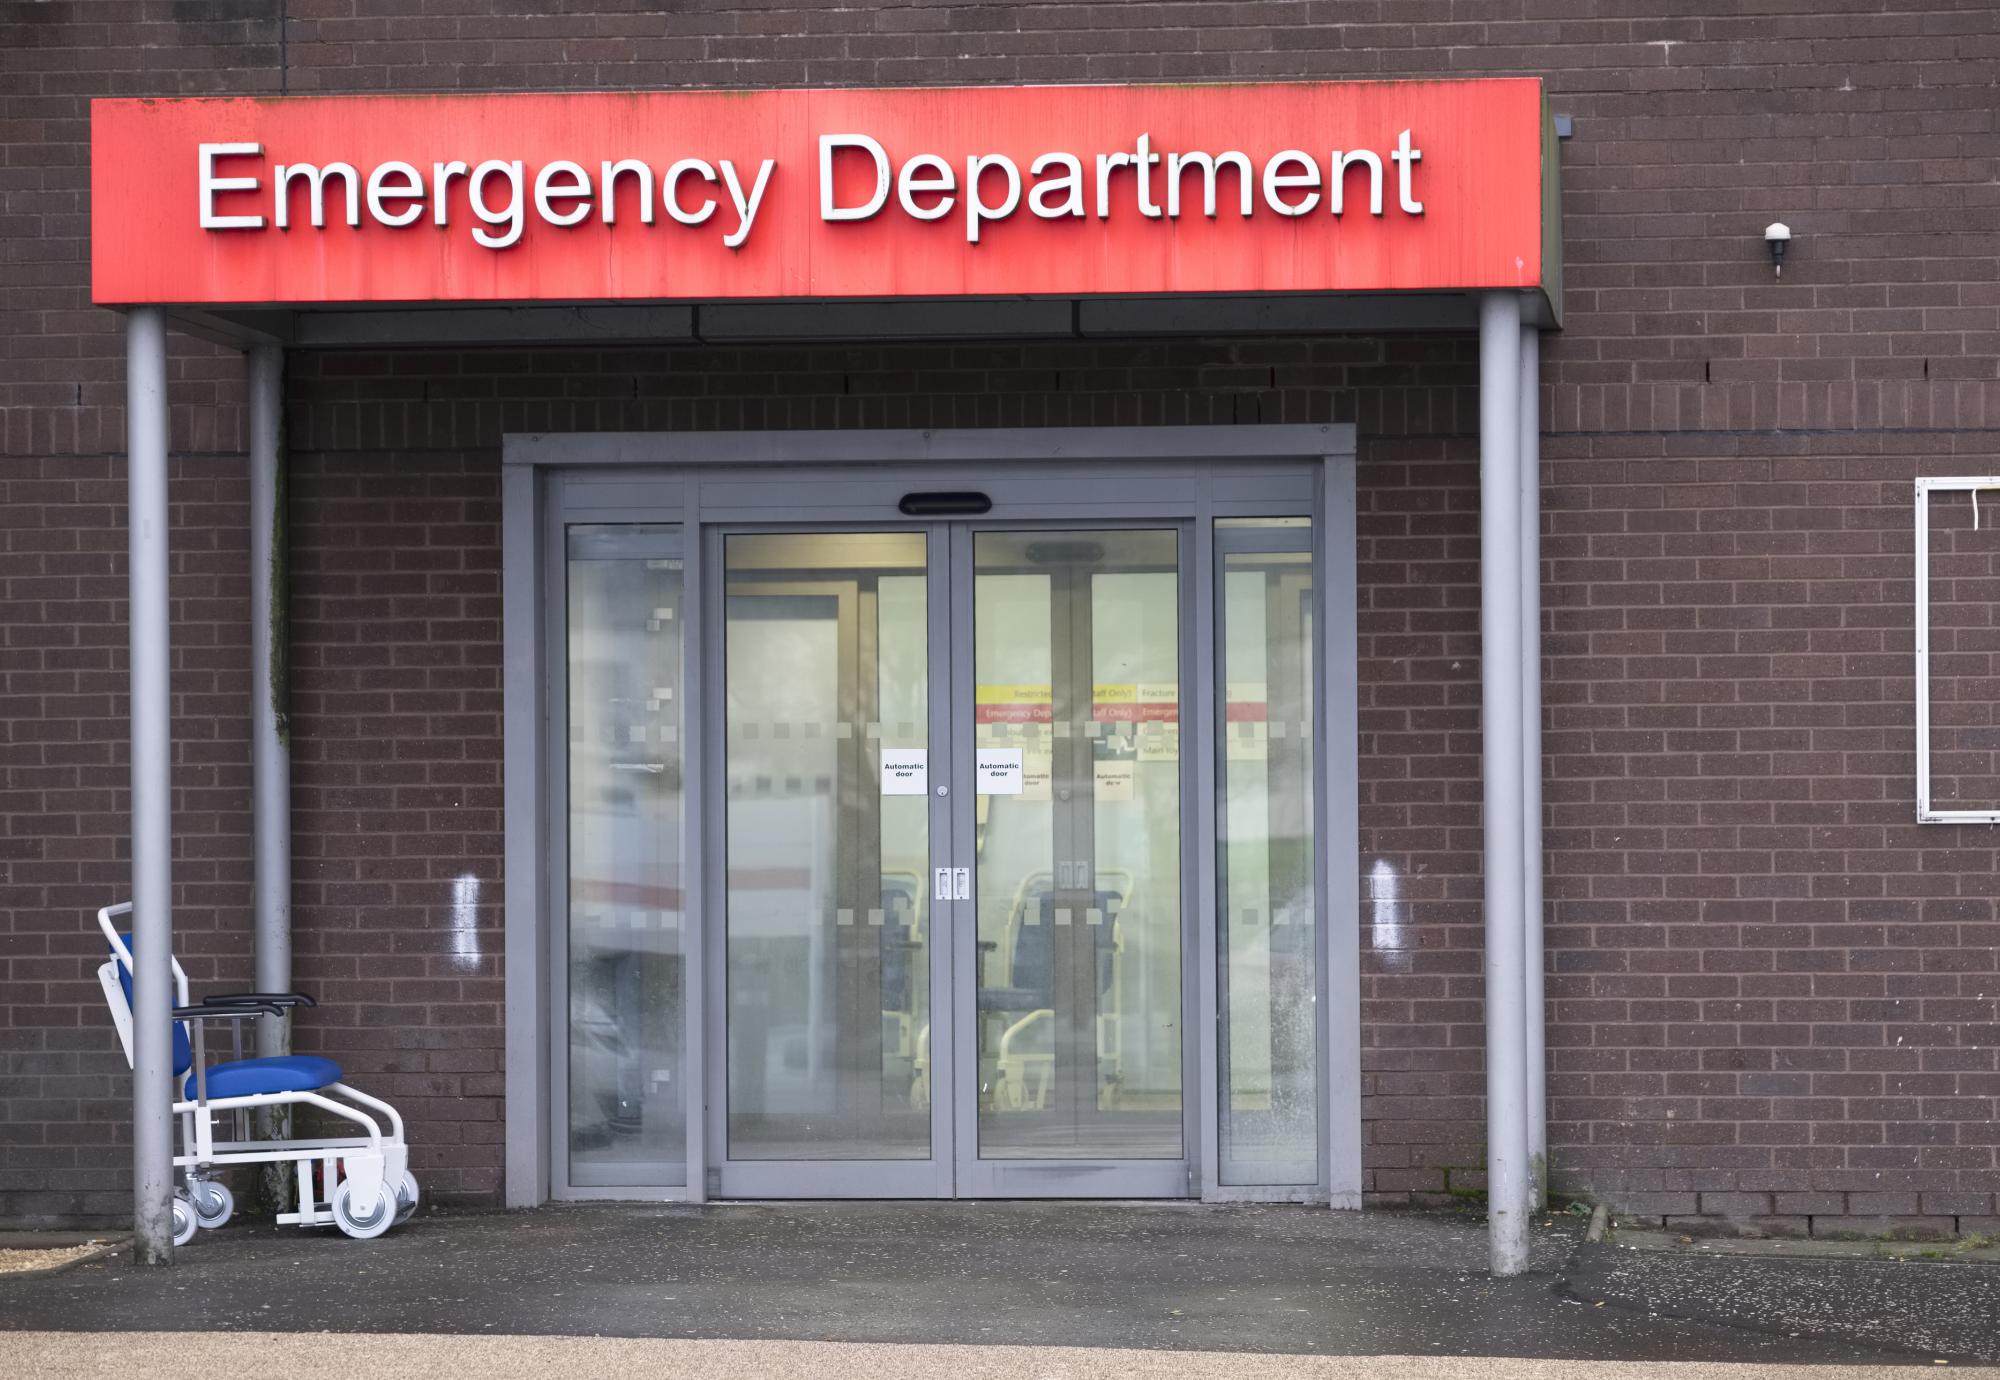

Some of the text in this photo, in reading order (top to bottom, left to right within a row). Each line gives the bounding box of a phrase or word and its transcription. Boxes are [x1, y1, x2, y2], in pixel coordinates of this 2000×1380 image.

[197, 127, 1426, 250] Emergency Department
[1142, 688, 1176, 697] Fracture
[986, 709, 1030, 720] Emergency
[1033, 709, 1052, 719] Dep
